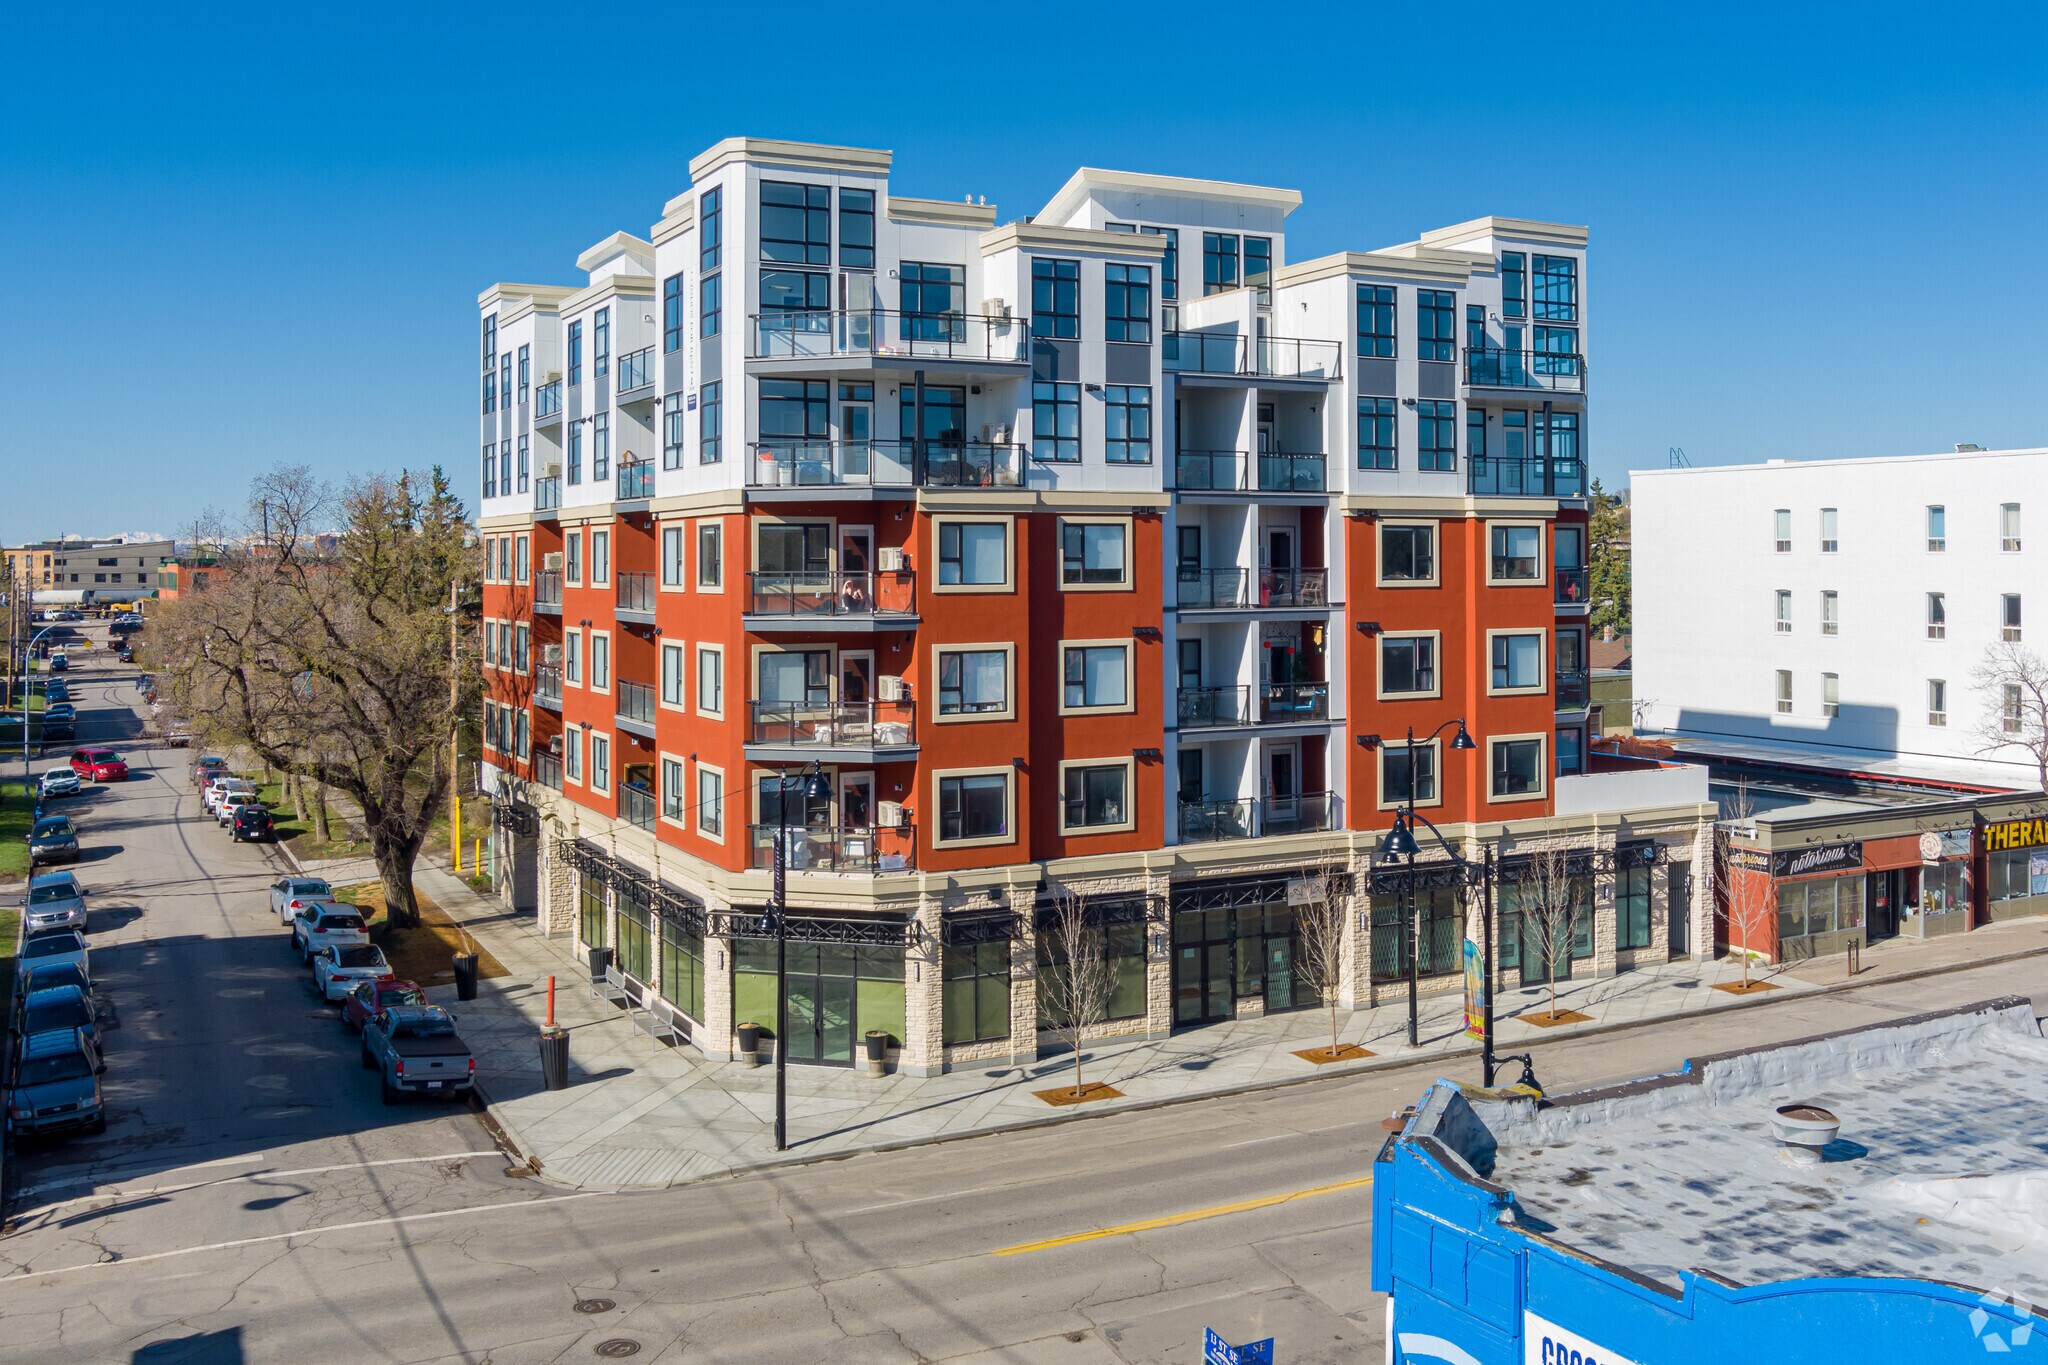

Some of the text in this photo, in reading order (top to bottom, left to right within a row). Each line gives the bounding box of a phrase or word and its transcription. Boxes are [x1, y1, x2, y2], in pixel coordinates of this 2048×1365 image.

[1983, 819, 2048, 851] THERA
[1728, 855, 1769, 868] notorious
[1789, 846, 1846, 875] notorious
[1211, 1333, 1216, 1345] 13
[1218, 1340, 1228, 1354] ST
[1229, 1350, 1238, 1364] SE
[1252, 1342, 1266, 1354] SE
